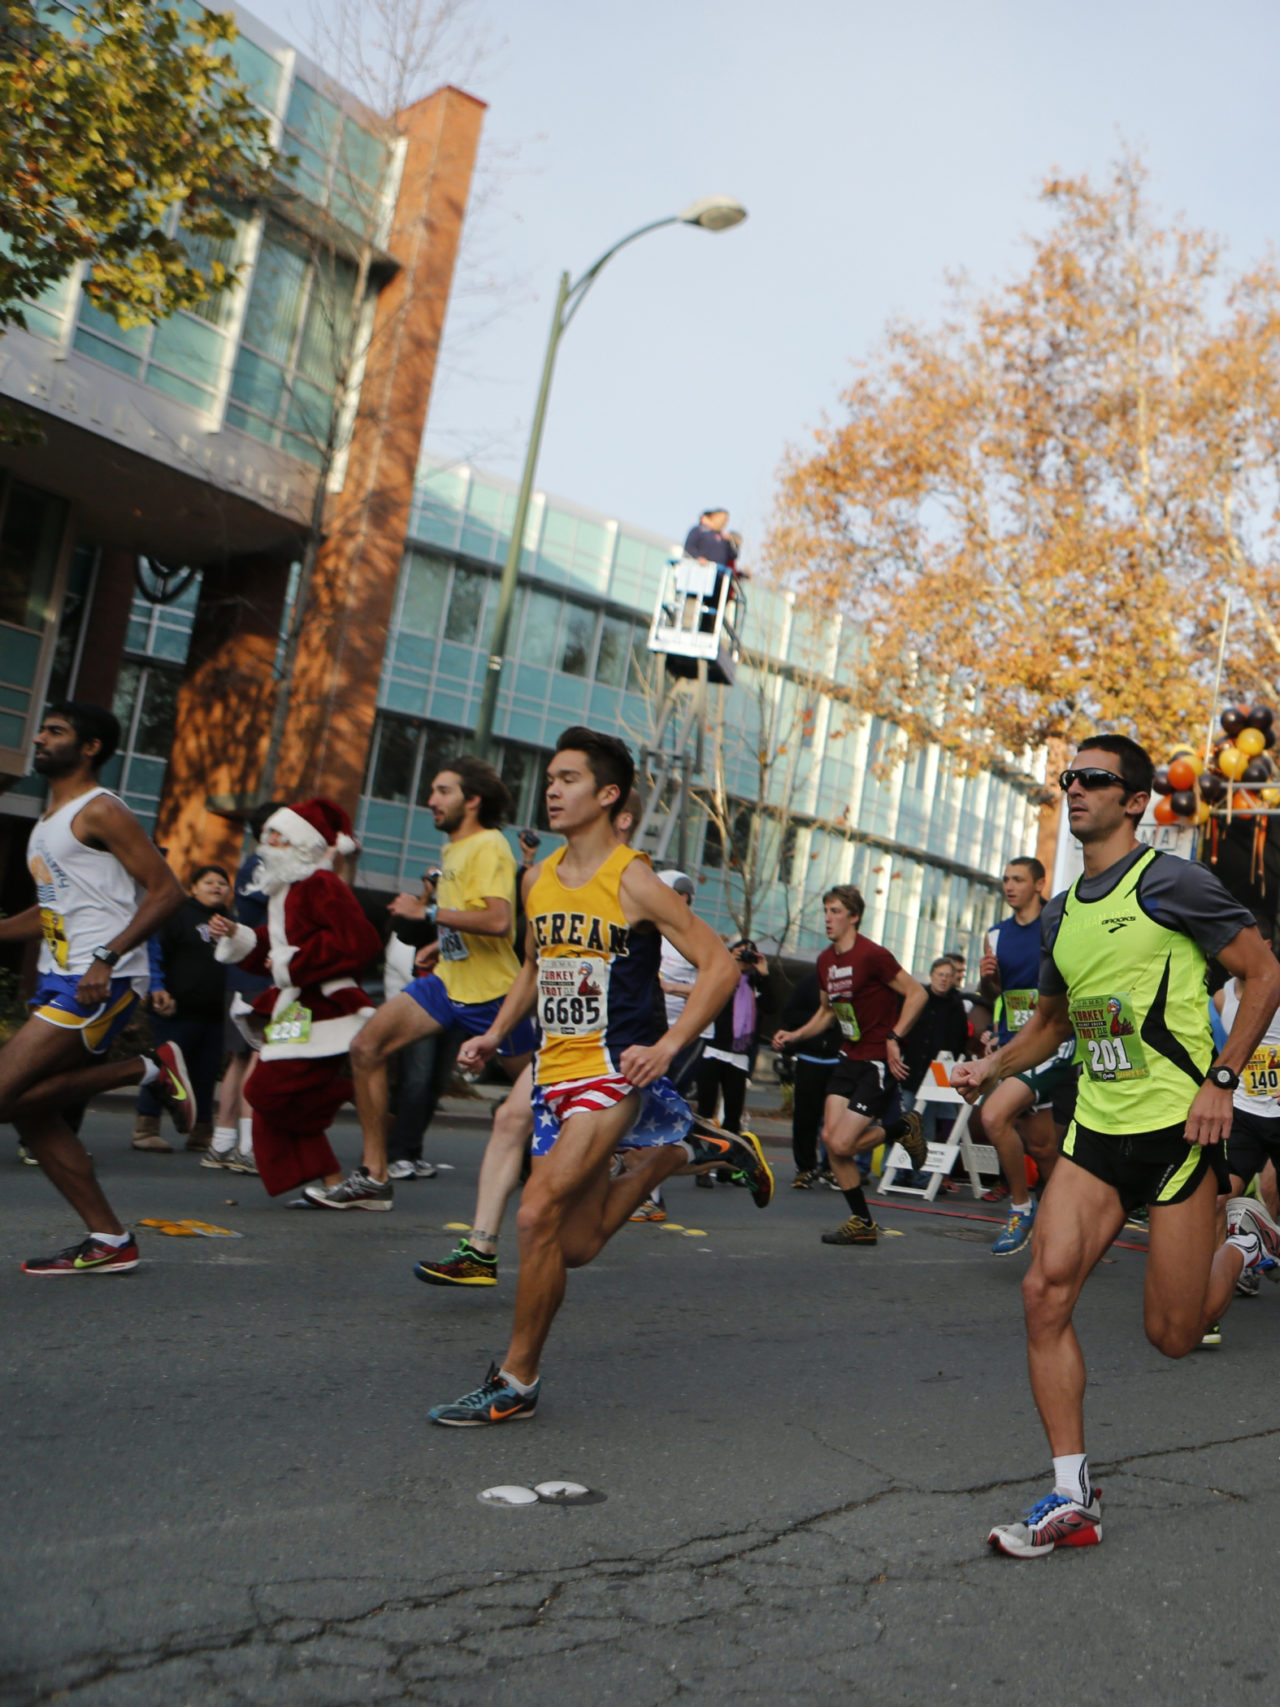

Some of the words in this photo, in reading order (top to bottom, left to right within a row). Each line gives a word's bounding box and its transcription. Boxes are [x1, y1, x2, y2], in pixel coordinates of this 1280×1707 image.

[1101, 915, 1137, 926] BROOKS
[541, 970, 575, 981] TURKEY
[541, 986, 563, 997] TROT
[543, 996, 601, 1025] 6685
[1071, 1008, 1105, 1023] TURKEY
[1077, 1027, 1097, 1039] TROT
[1087, 1037, 1132, 1072] 201
[1250, 1069, 1279, 1090] 140
